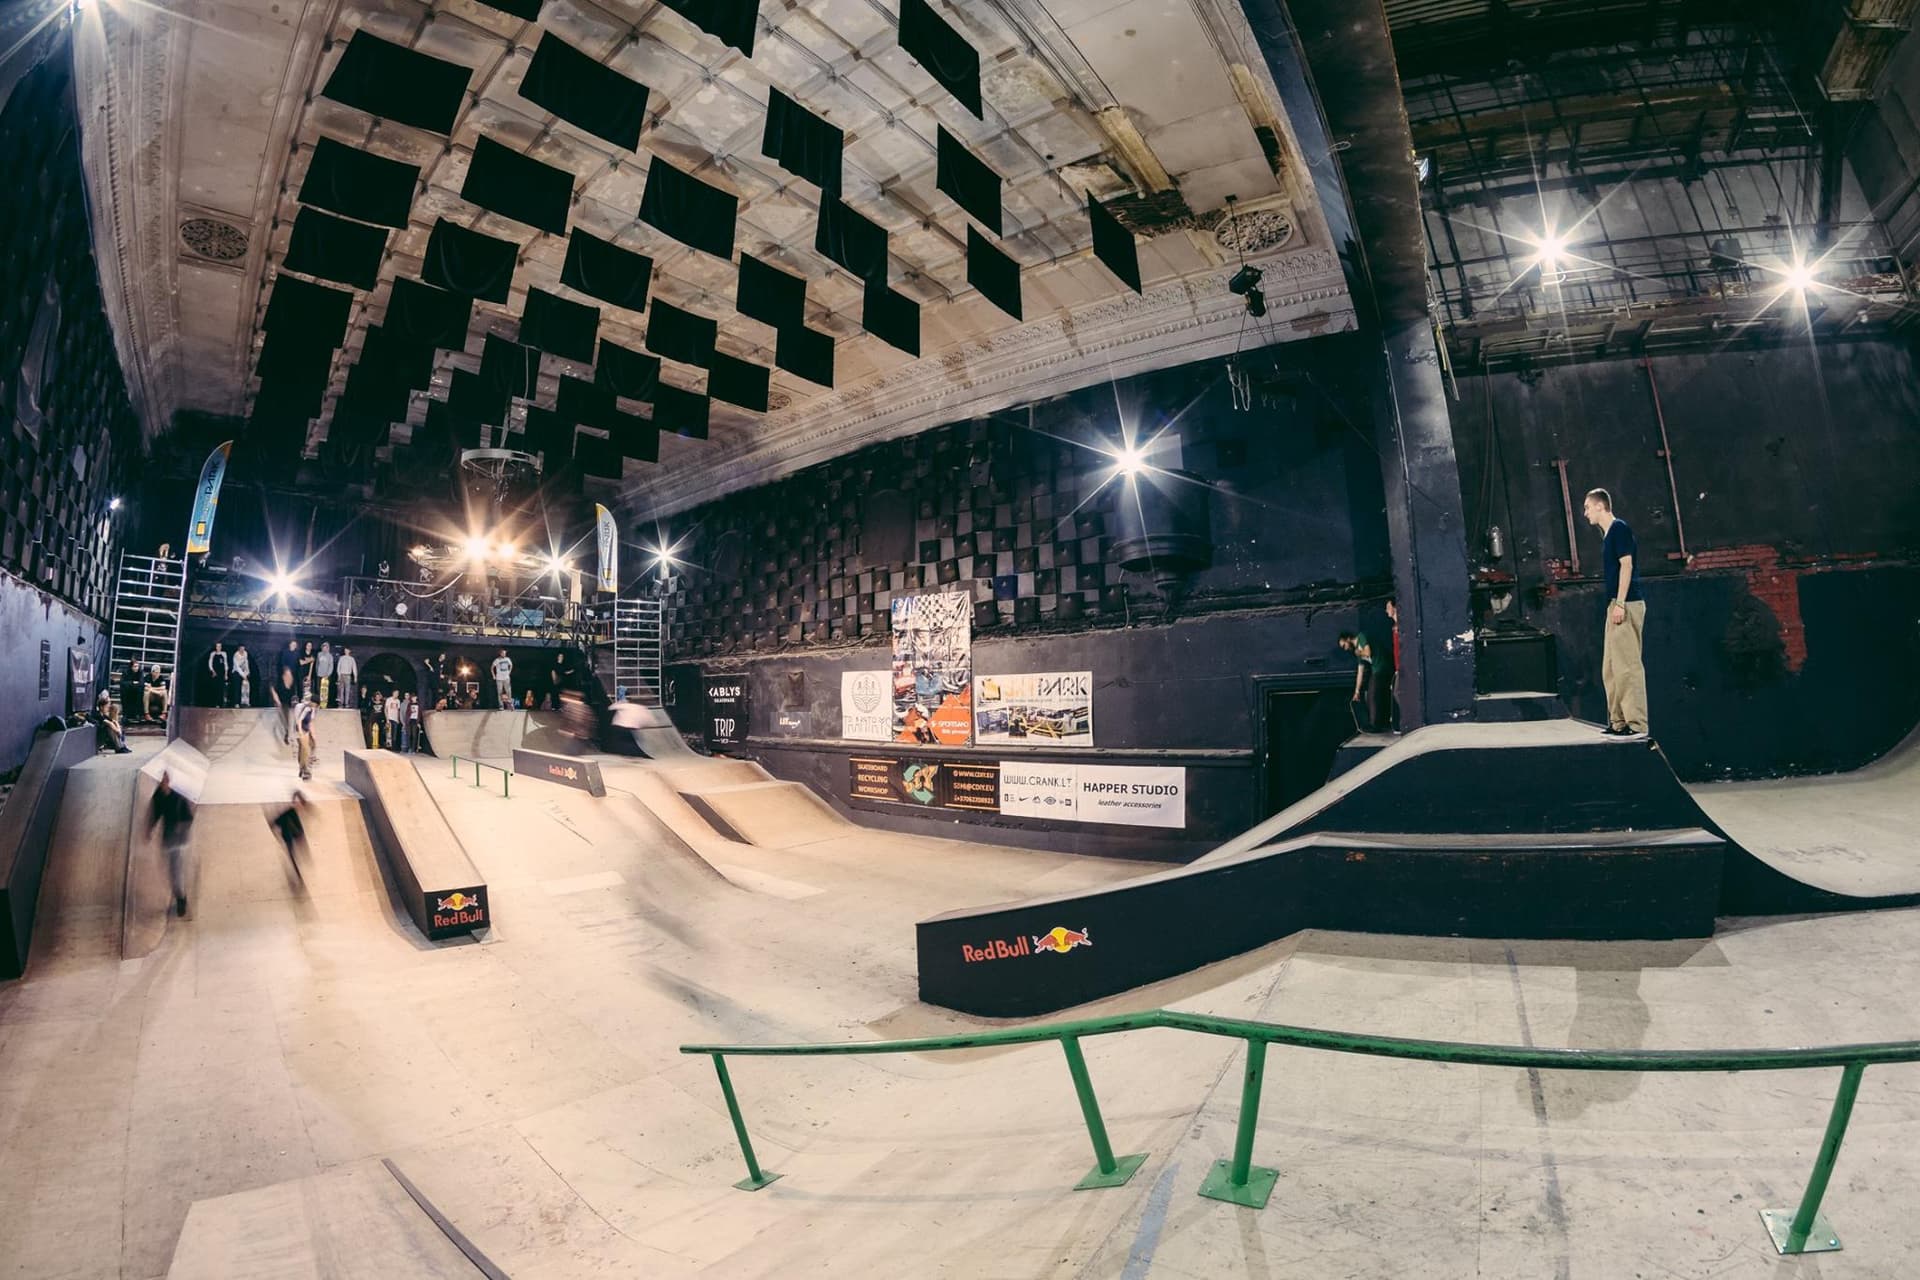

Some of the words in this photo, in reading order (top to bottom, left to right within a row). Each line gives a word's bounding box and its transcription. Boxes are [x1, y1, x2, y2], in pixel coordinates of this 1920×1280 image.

[713, 718, 736, 737] TRIP
[857, 774, 889, 784] RECYCLING
[1003, 775, 1073, 788] WWW.CRANK.LT
[857, 785, 889, 794] WORKSHOP
[1083, 782, 1128, 794] HAPPER
[1131, 784, 1178, 796] STUDIO
[1098, 799, 1122, 808] leather
[1123, 801, 1162, 809] accessories
[433, 912, 458, 928] Red
[459, 909, 483, 924] Bull
[962, 941, 996, 962] Red
[995, 936, 1030, 958] Bull
